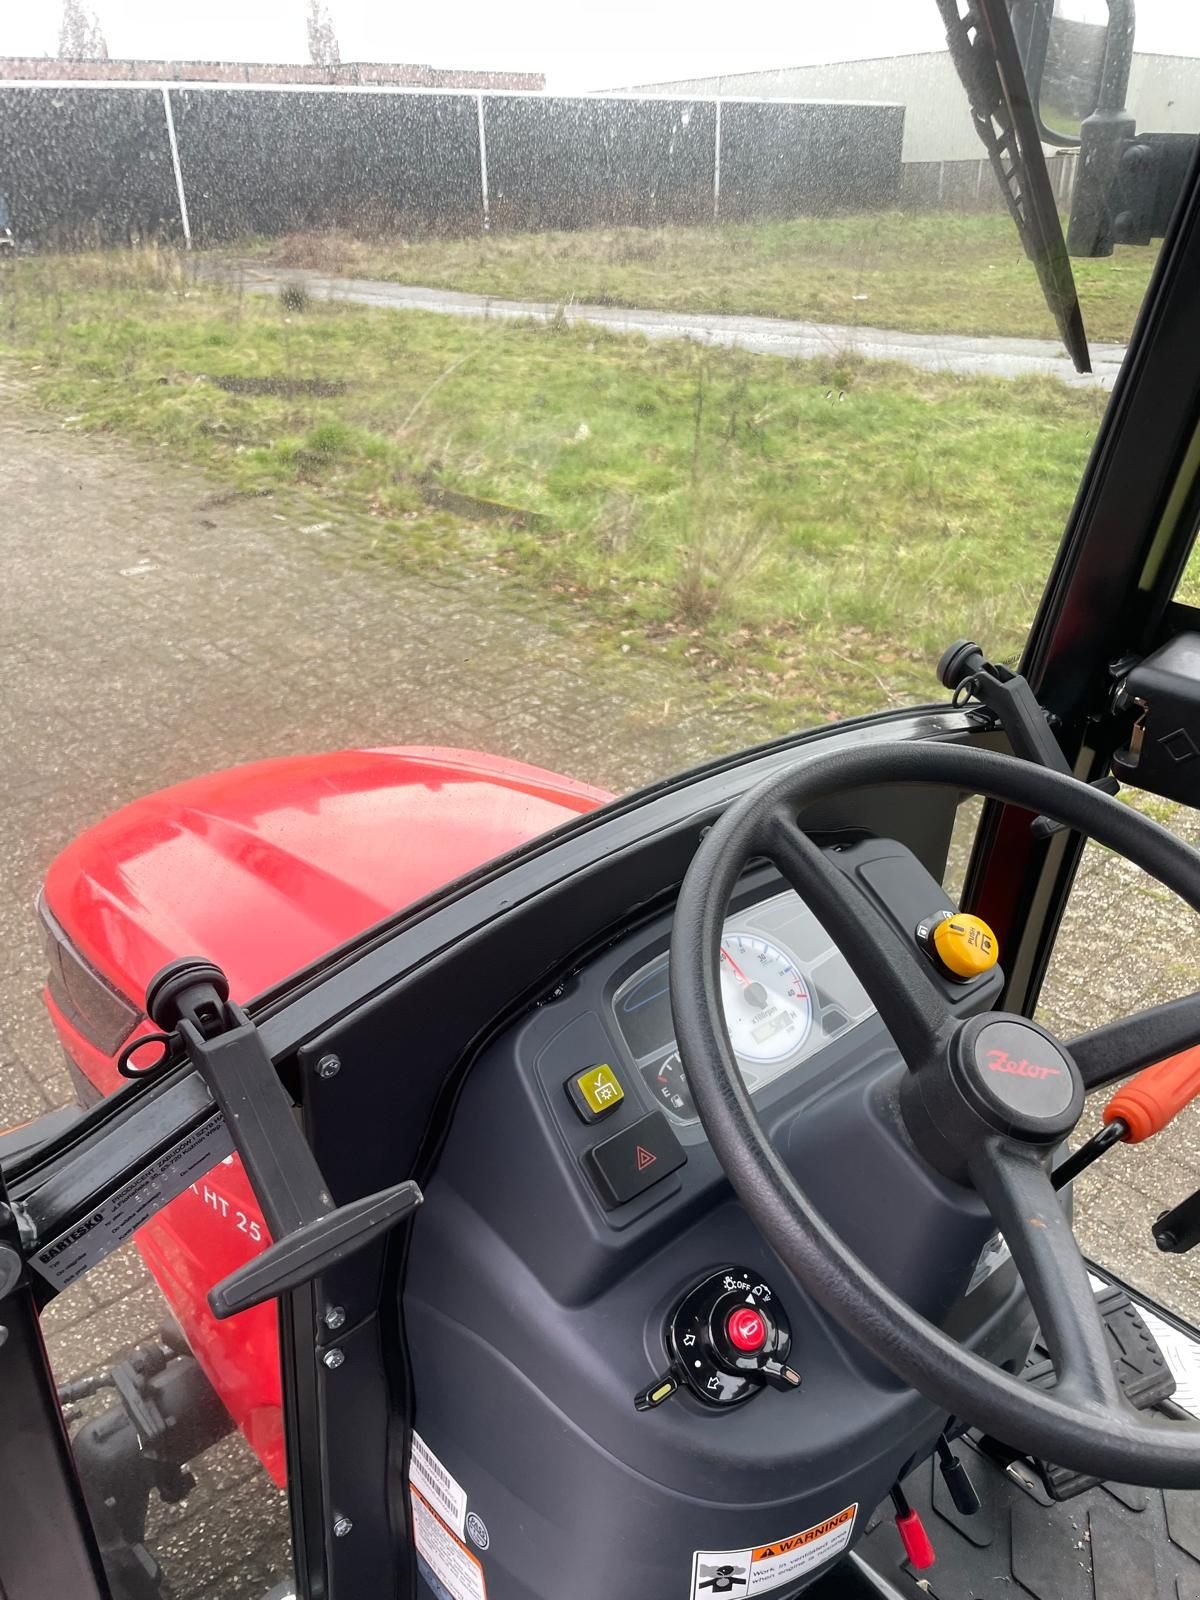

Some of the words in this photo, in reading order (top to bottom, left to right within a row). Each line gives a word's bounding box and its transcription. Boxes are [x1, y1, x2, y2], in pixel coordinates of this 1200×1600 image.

[967, 926, 976, 945] PUSH
[986, 1049, 1062, 1080] Zetor
[661, 1086, 671, 1098] E
[111, 1168, 156, 1204] PRODUCENT
[204, 1185, 230, 1217] HT
[236, 1212, 261, 1242] 25
[39, 1213, 104, 1265] BARTESKO
[736, 1281, 751, 1291] OFF
[779, 1512, 849, 1552] WARNING
[753, 1567, 775, 1577] Work
